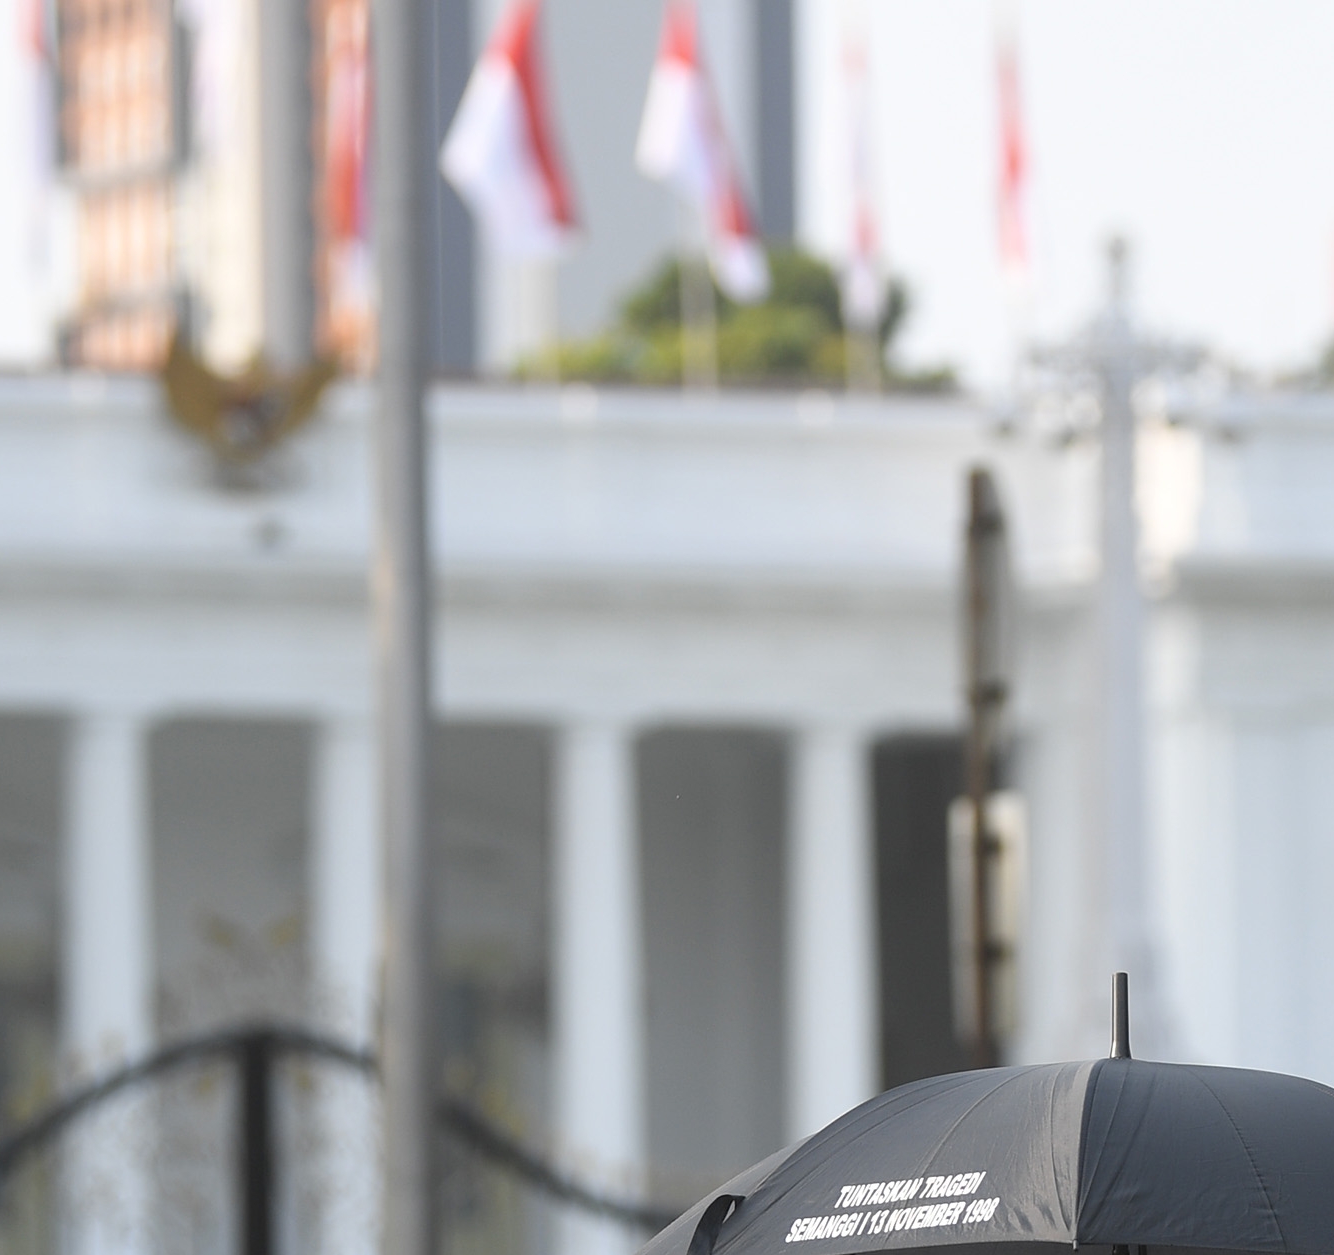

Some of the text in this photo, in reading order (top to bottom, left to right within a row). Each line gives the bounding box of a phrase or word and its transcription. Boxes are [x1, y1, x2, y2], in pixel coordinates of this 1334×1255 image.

[834, 1171, 986, 1208] TUNTASKAN TRAGEDI
[785, 1212, 861, 1243] SEMANGGI
[867, 1209, 888, 1235] 13
[885, 1201, 966, 1232] NOVEMBER
[962, 1197, 1000, 1224] 1998
